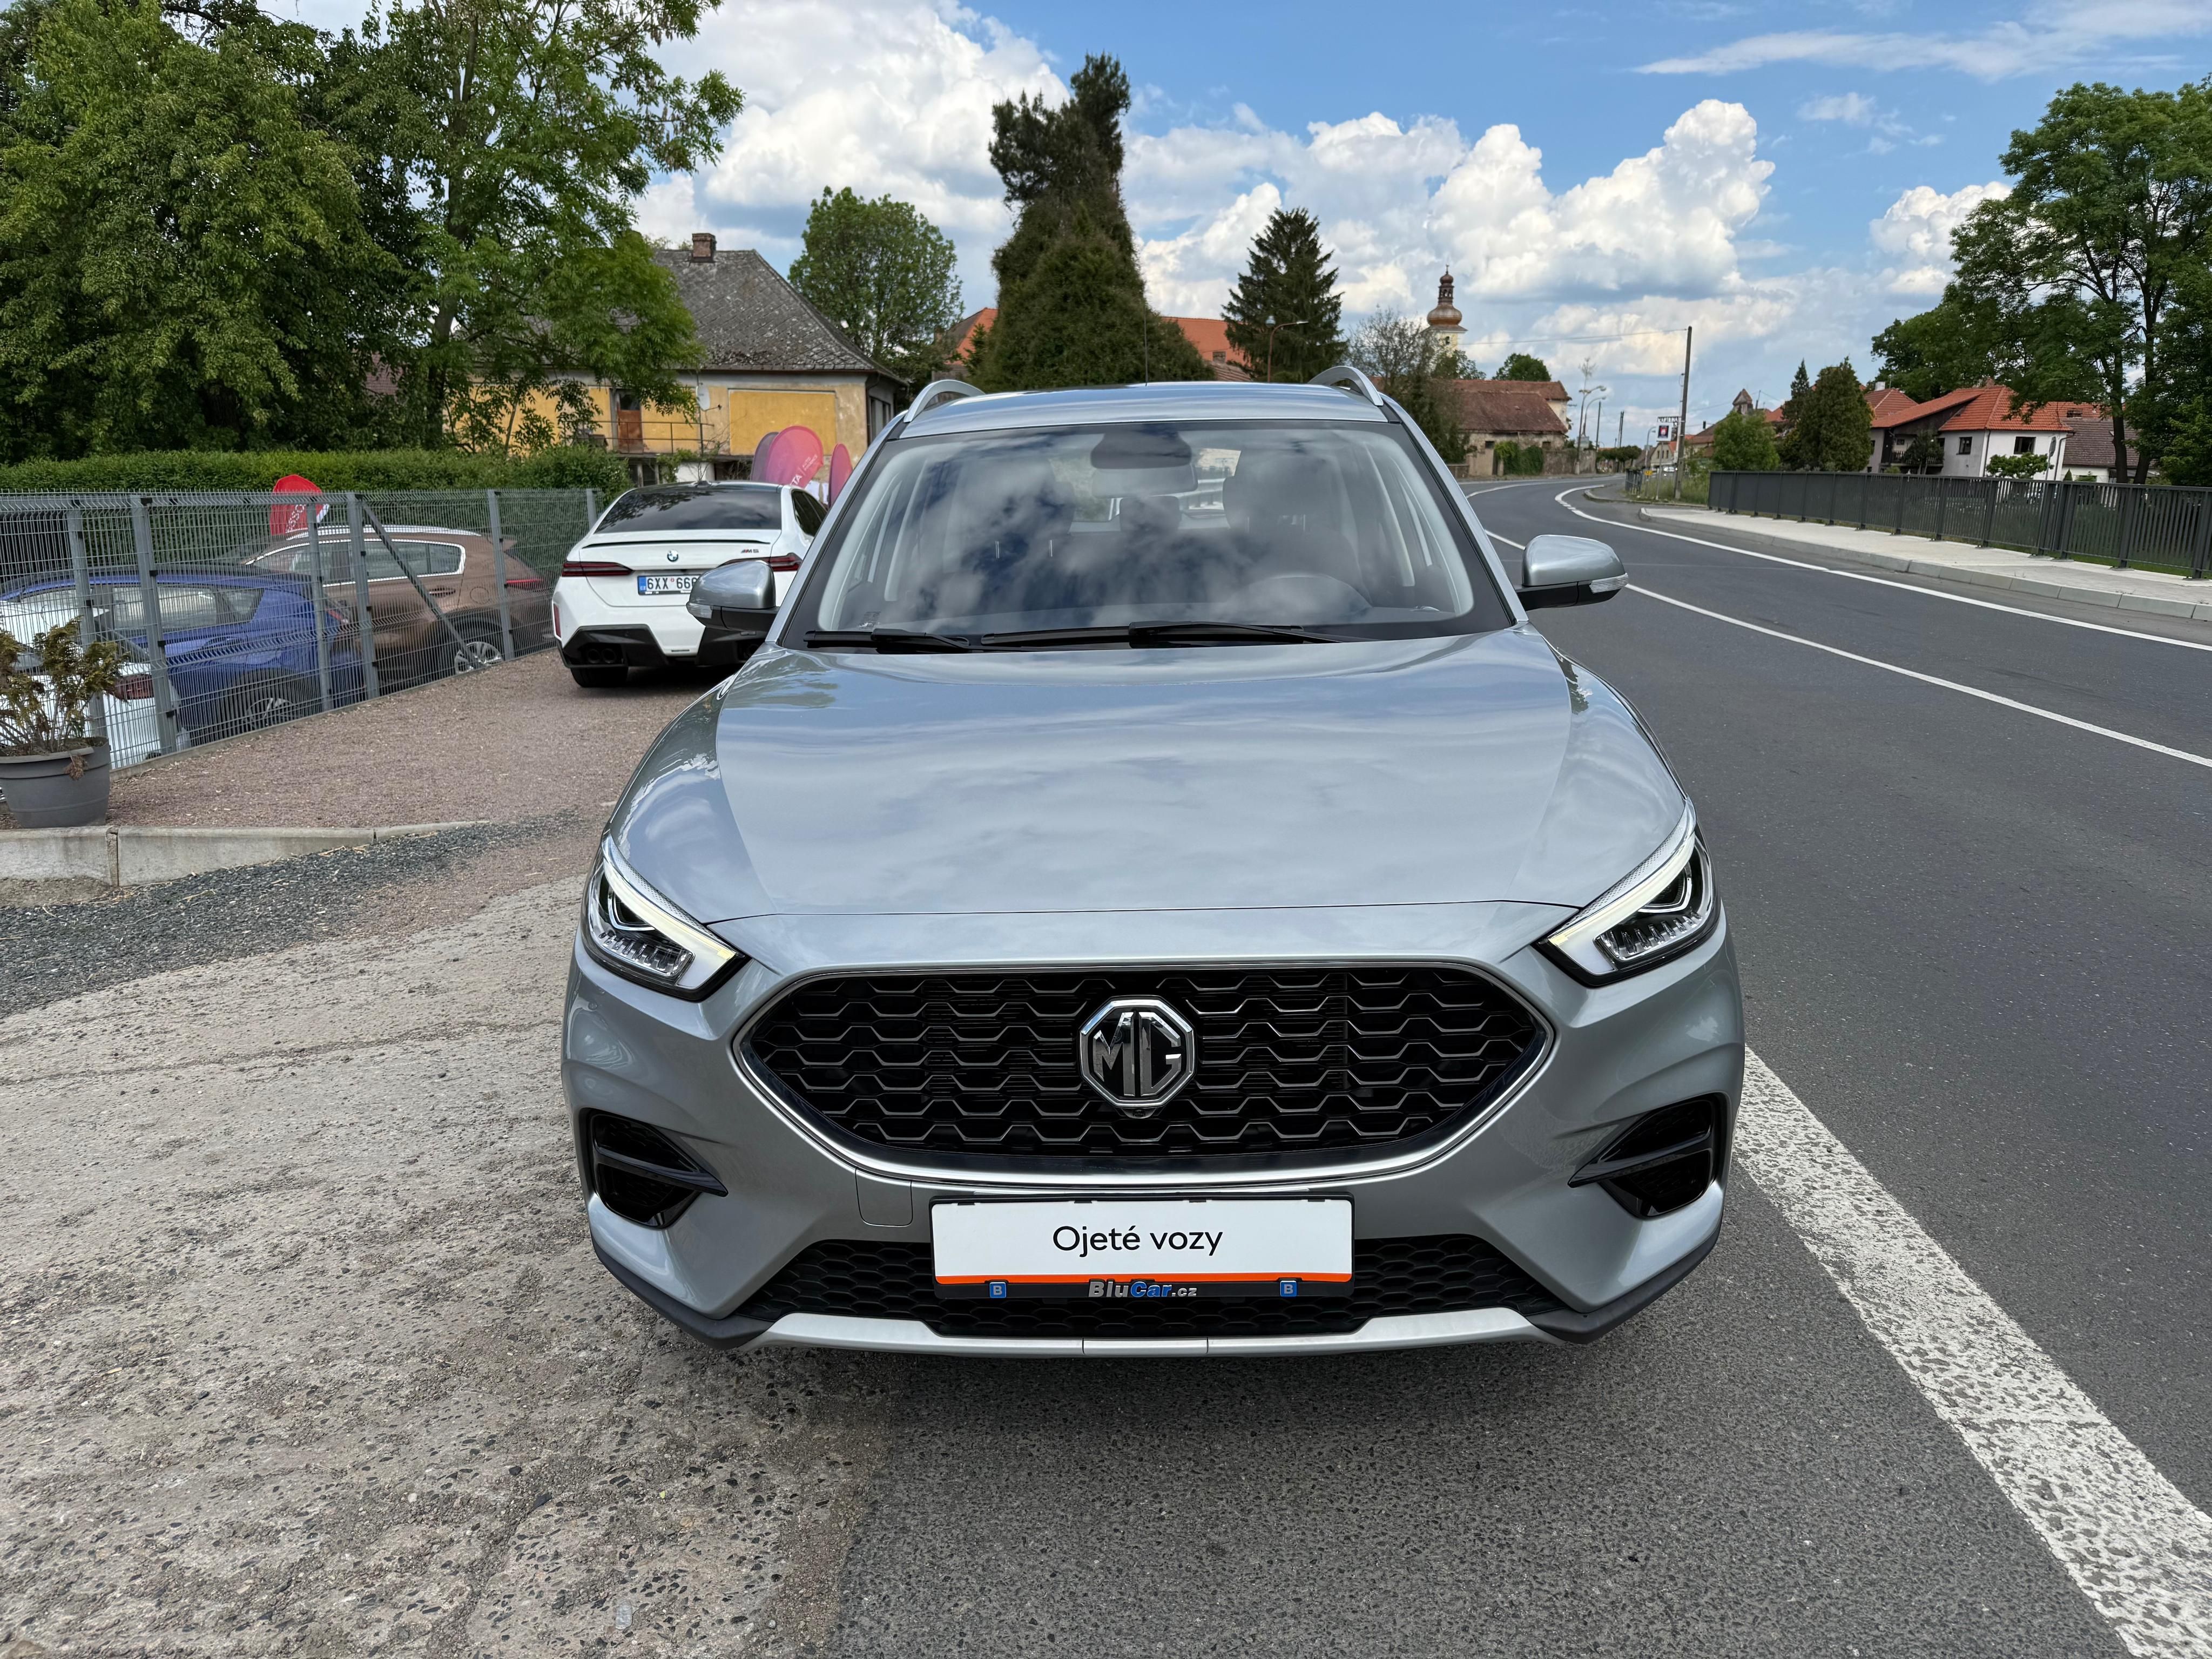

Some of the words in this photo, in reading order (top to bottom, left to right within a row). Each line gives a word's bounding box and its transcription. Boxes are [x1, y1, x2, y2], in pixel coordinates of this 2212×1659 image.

[648, 578, 669, 590] 6XX
[1093, 1011, 1182, 1097] MG
[1053, 1225, 1141, 1257] Ojeté
[1150, 1232, 1223, 1256] vozy
[993, 1285, 1002, 1295] B
[1089, 1281, 1197, 1297] BluCar.cz
[1284, 1284, 1293, 1294] B
